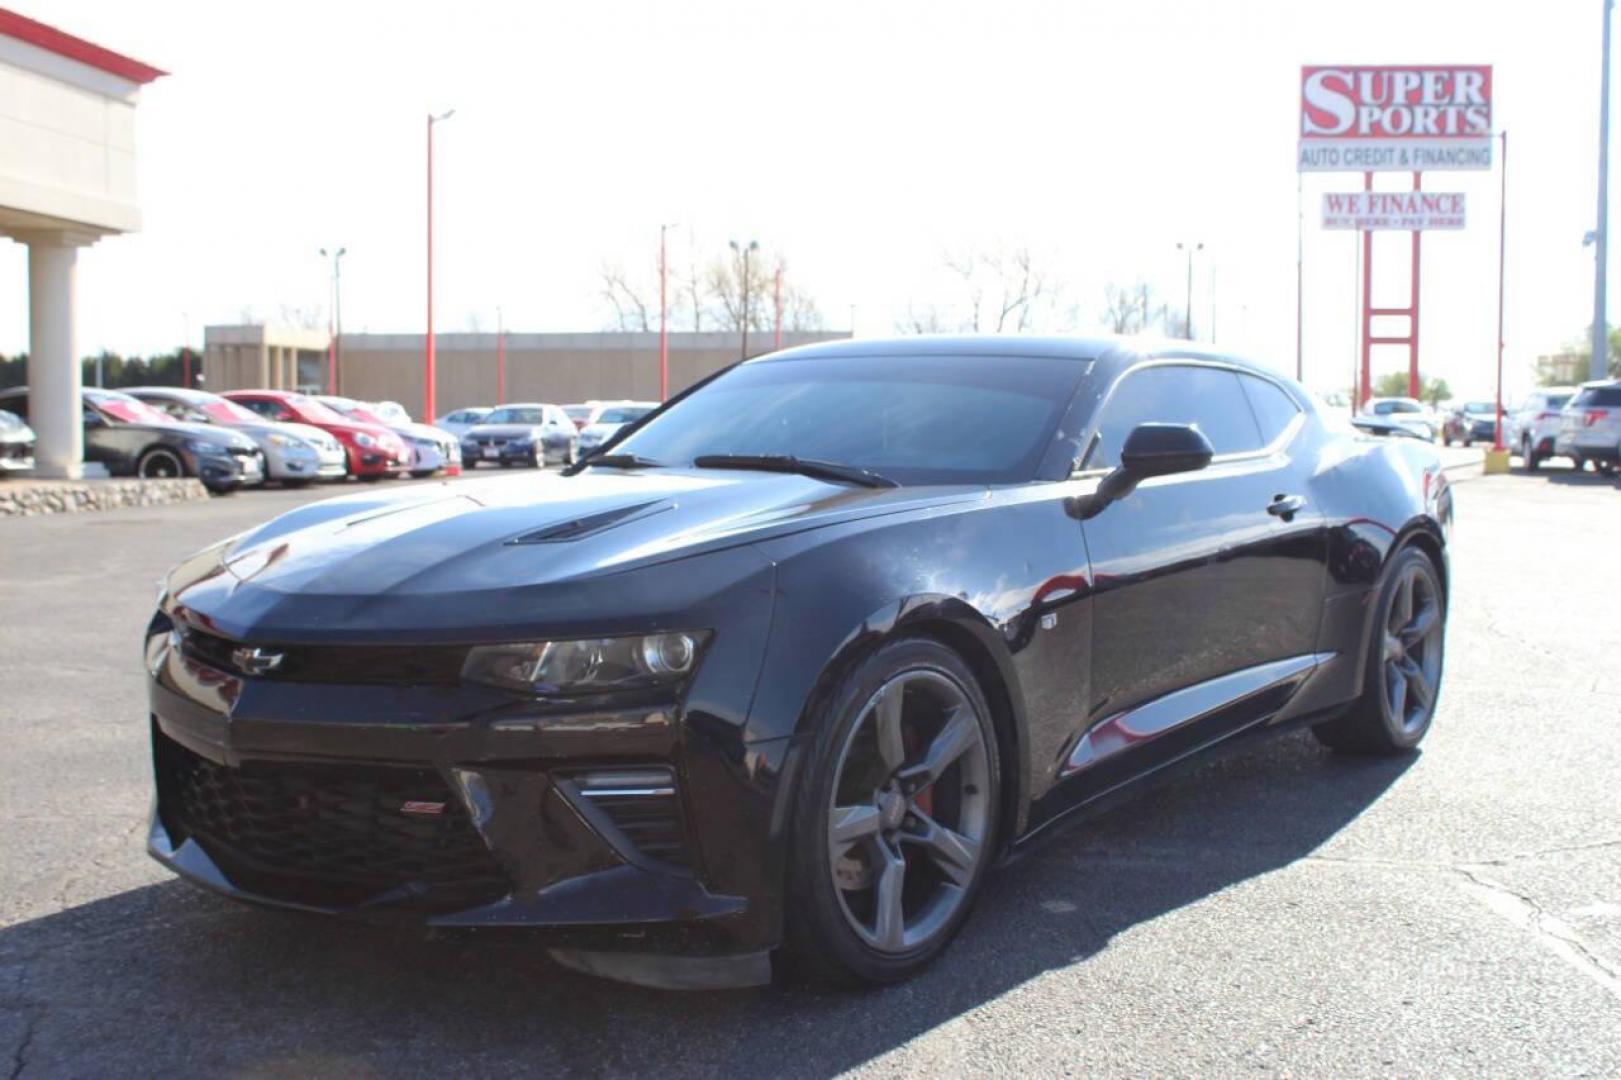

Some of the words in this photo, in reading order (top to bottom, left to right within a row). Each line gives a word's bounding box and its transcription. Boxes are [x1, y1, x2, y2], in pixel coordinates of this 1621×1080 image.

[1304, 69, 1487, 134] SUPER
[1300, 147, 1340, 165] AUTO
[1343, 147, 1395, 165] CREDIT
[1400, 148, 1409, 165] &
[1414, 147, 1491, 165] FINANCING
[1326, 194, 1360, 214] WE
[1367, 194, 1465, 214] FINANCE
